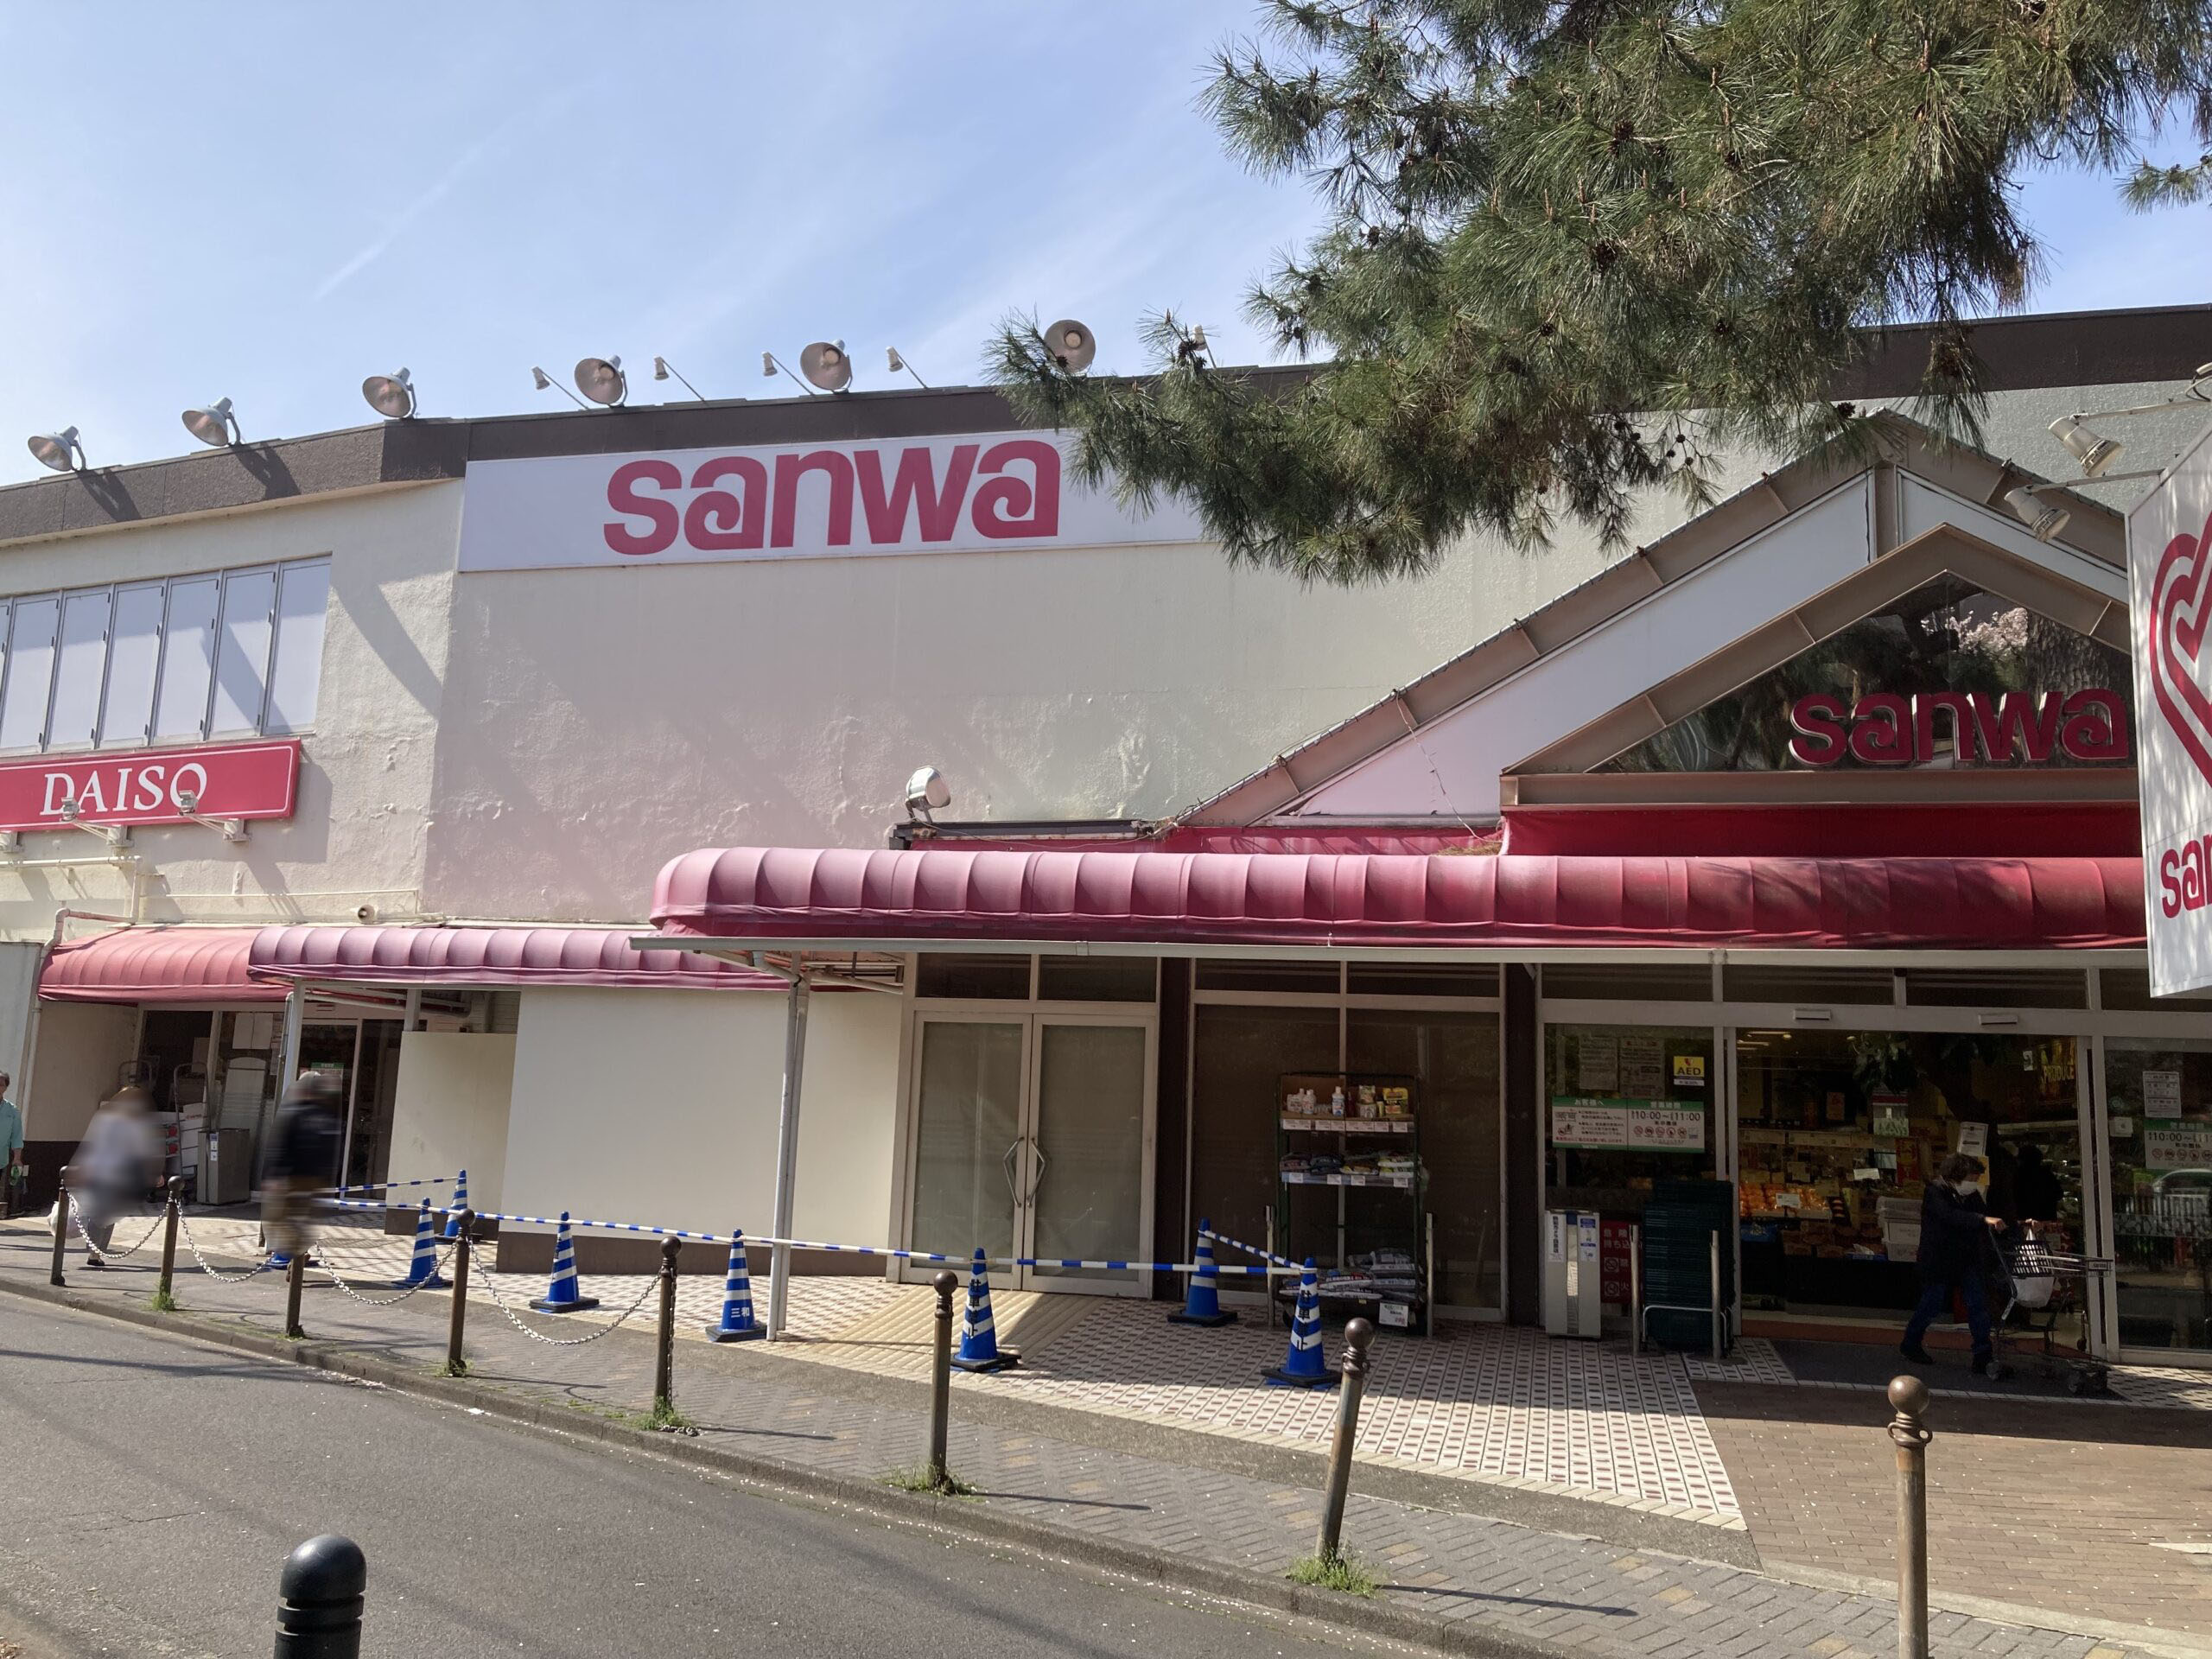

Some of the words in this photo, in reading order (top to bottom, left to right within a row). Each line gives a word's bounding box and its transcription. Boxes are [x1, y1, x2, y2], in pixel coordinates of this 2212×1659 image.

[604, 440, 1061, 556] sanwa
[1788, 688, 2129, 766] sanwa
[40, 762, 207, 816] DAISO
[1677, 1066, 1701, 1076] AED
[730, 1306, 750, 1318] 三和
